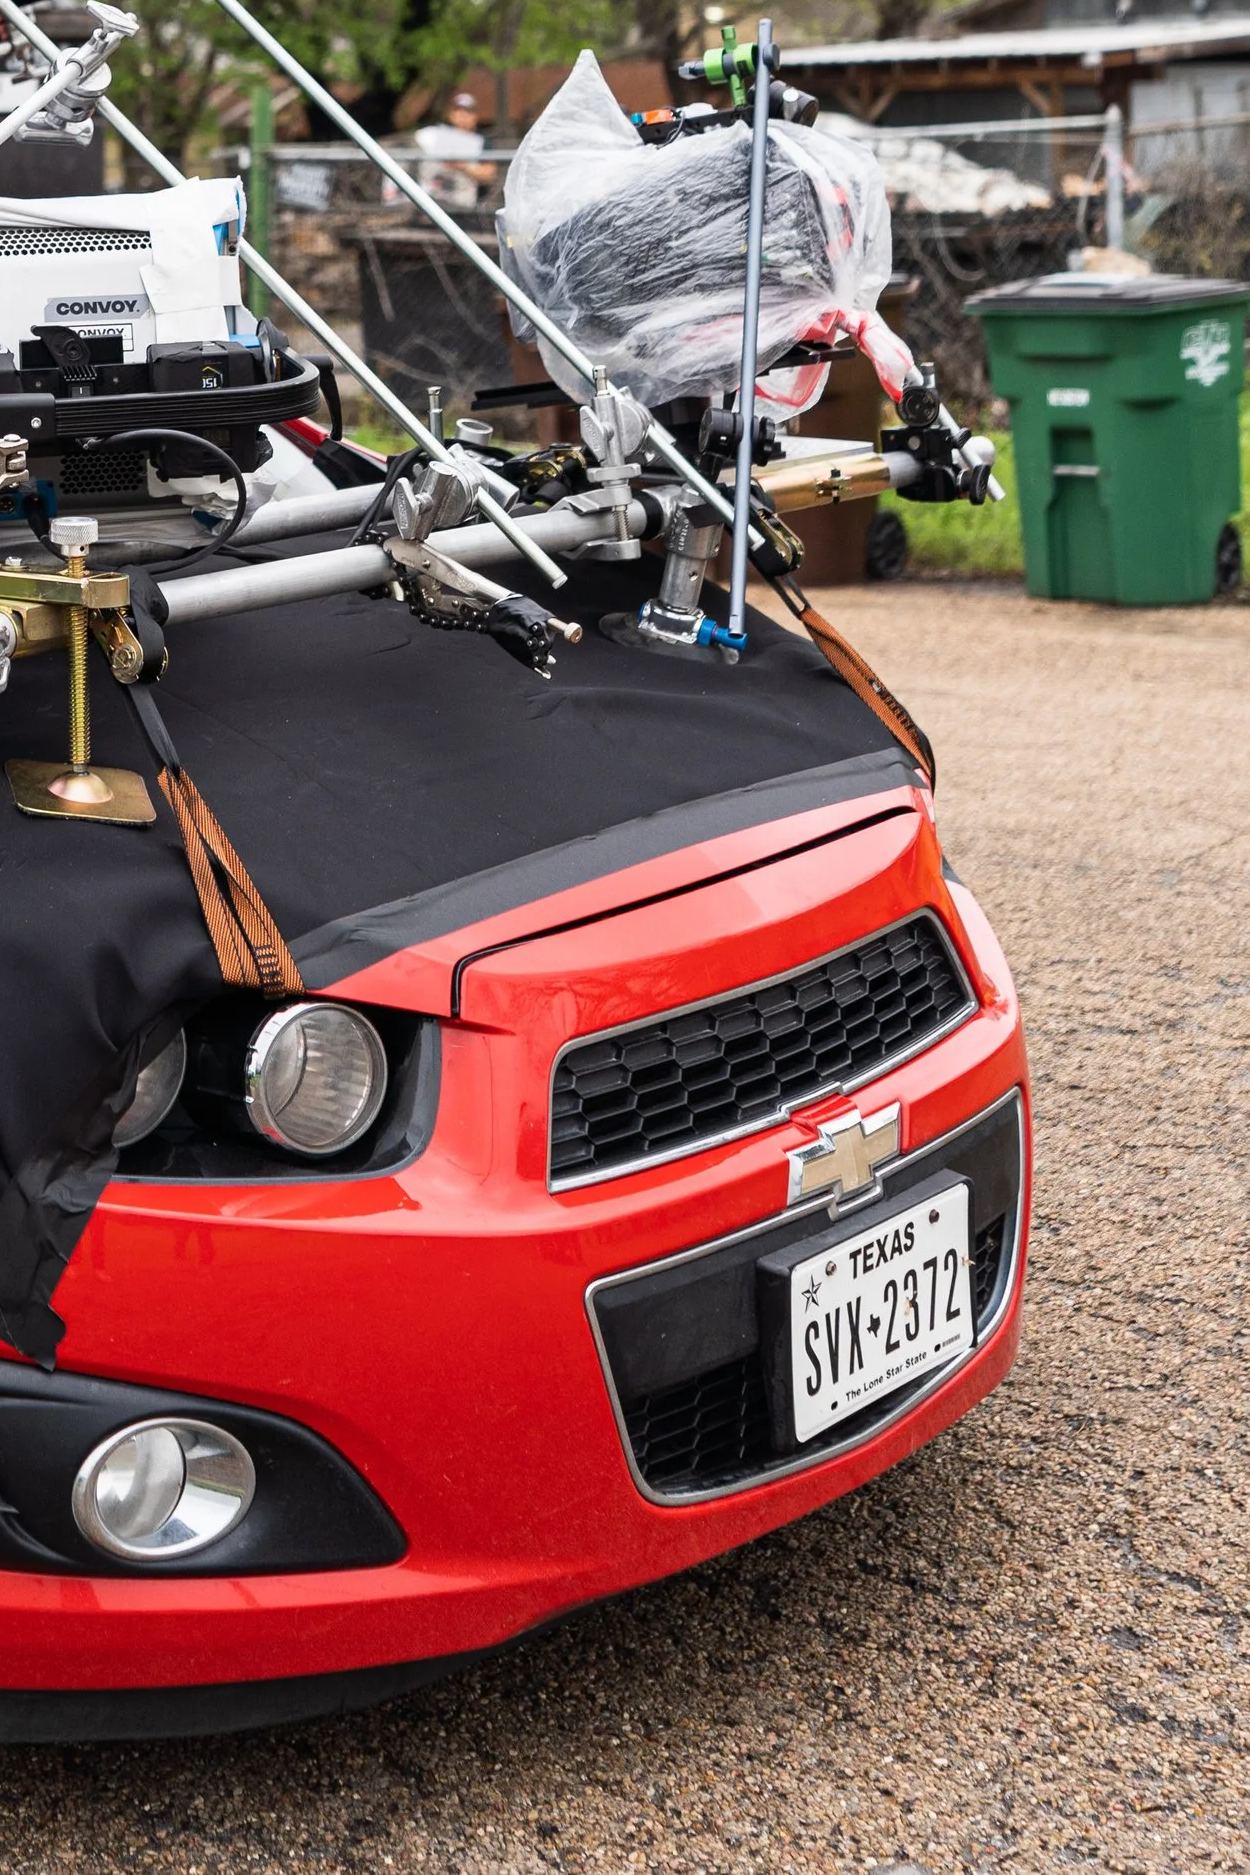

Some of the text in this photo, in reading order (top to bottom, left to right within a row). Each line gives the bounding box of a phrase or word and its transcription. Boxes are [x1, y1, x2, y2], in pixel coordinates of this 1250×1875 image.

[56, 299, 140, 316] CONVOY.
[849, 1221, 915, 1279] TEXAS
[845, 1351, 927, 1402] The Lone Star State
